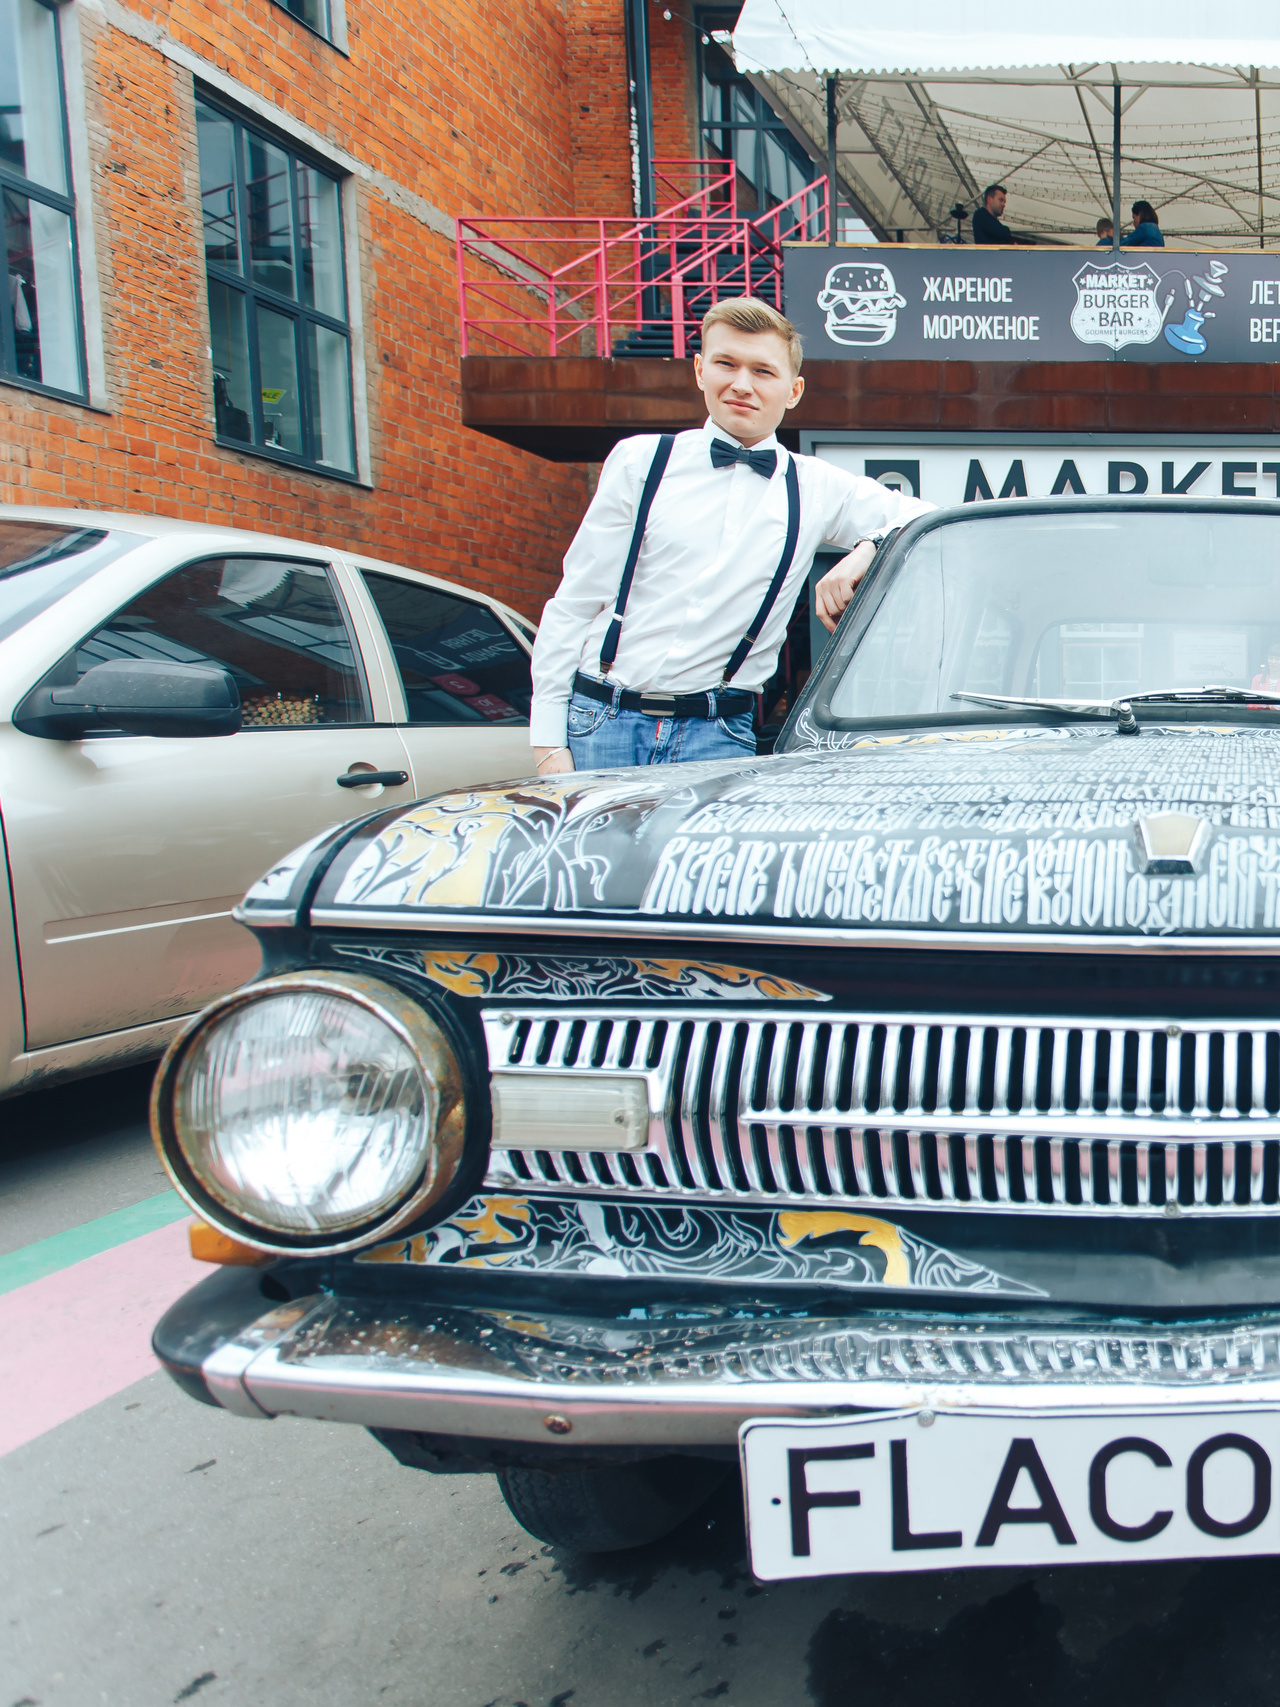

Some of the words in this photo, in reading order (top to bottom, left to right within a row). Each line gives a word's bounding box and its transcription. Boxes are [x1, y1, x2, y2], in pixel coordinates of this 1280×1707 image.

[1086, 273, 1148, 289] MARKET
[922, 276, 1013, 303] ЖАРЕНОЕ
[1083, 294, 1149, 309] BURGER
[1098, 311, 1134, 327] BAR
[923, 314, 1040, 341] МОРОЖЕНОЕ
